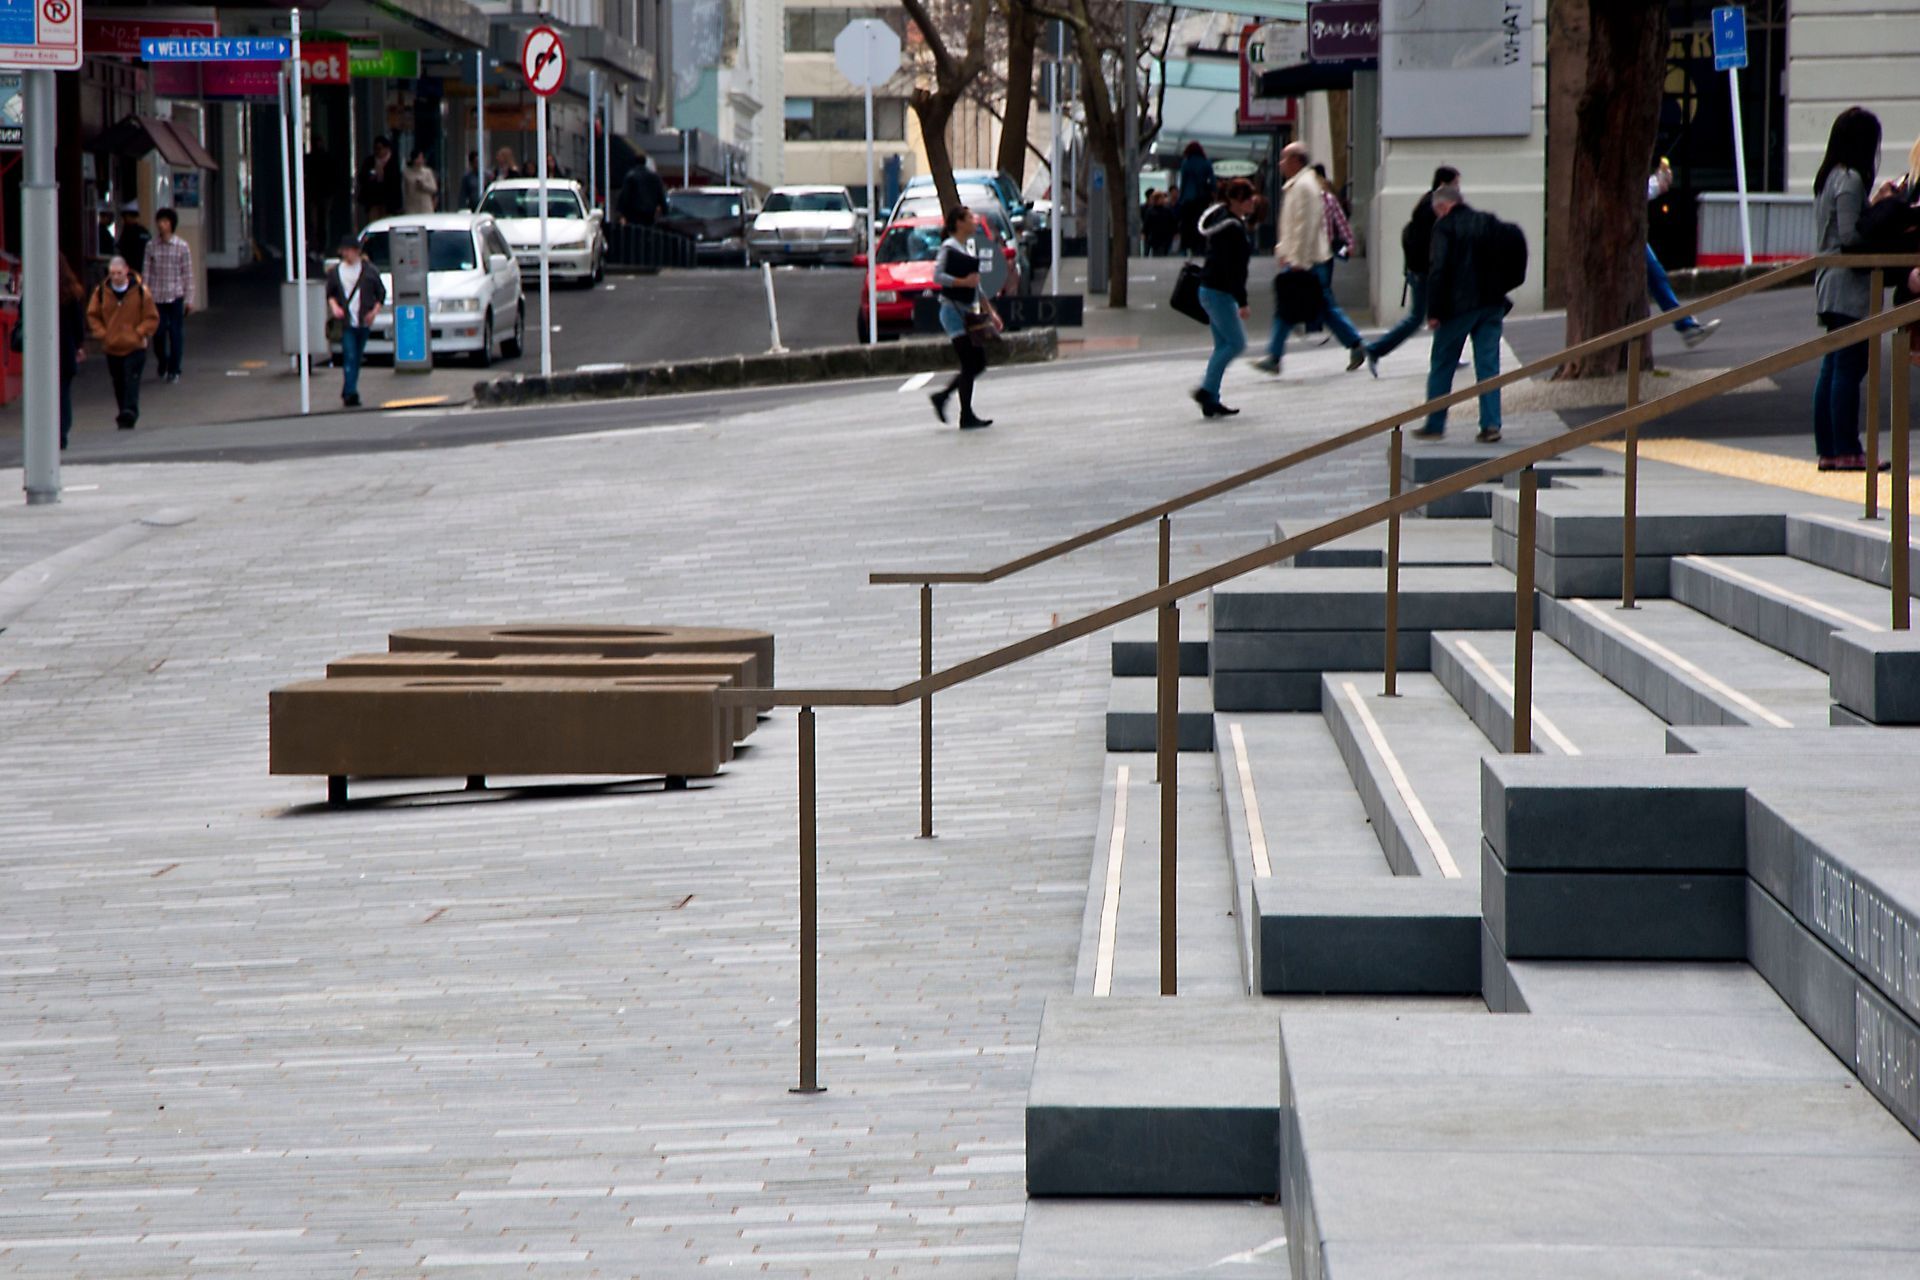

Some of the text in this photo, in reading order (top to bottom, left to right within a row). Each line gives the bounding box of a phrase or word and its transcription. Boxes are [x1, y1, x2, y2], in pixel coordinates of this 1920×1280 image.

[158, 41, 231, 57] WELLESLEY
[236, 41, 251, 57] ST
[255, 41, 275, 50] EAST
